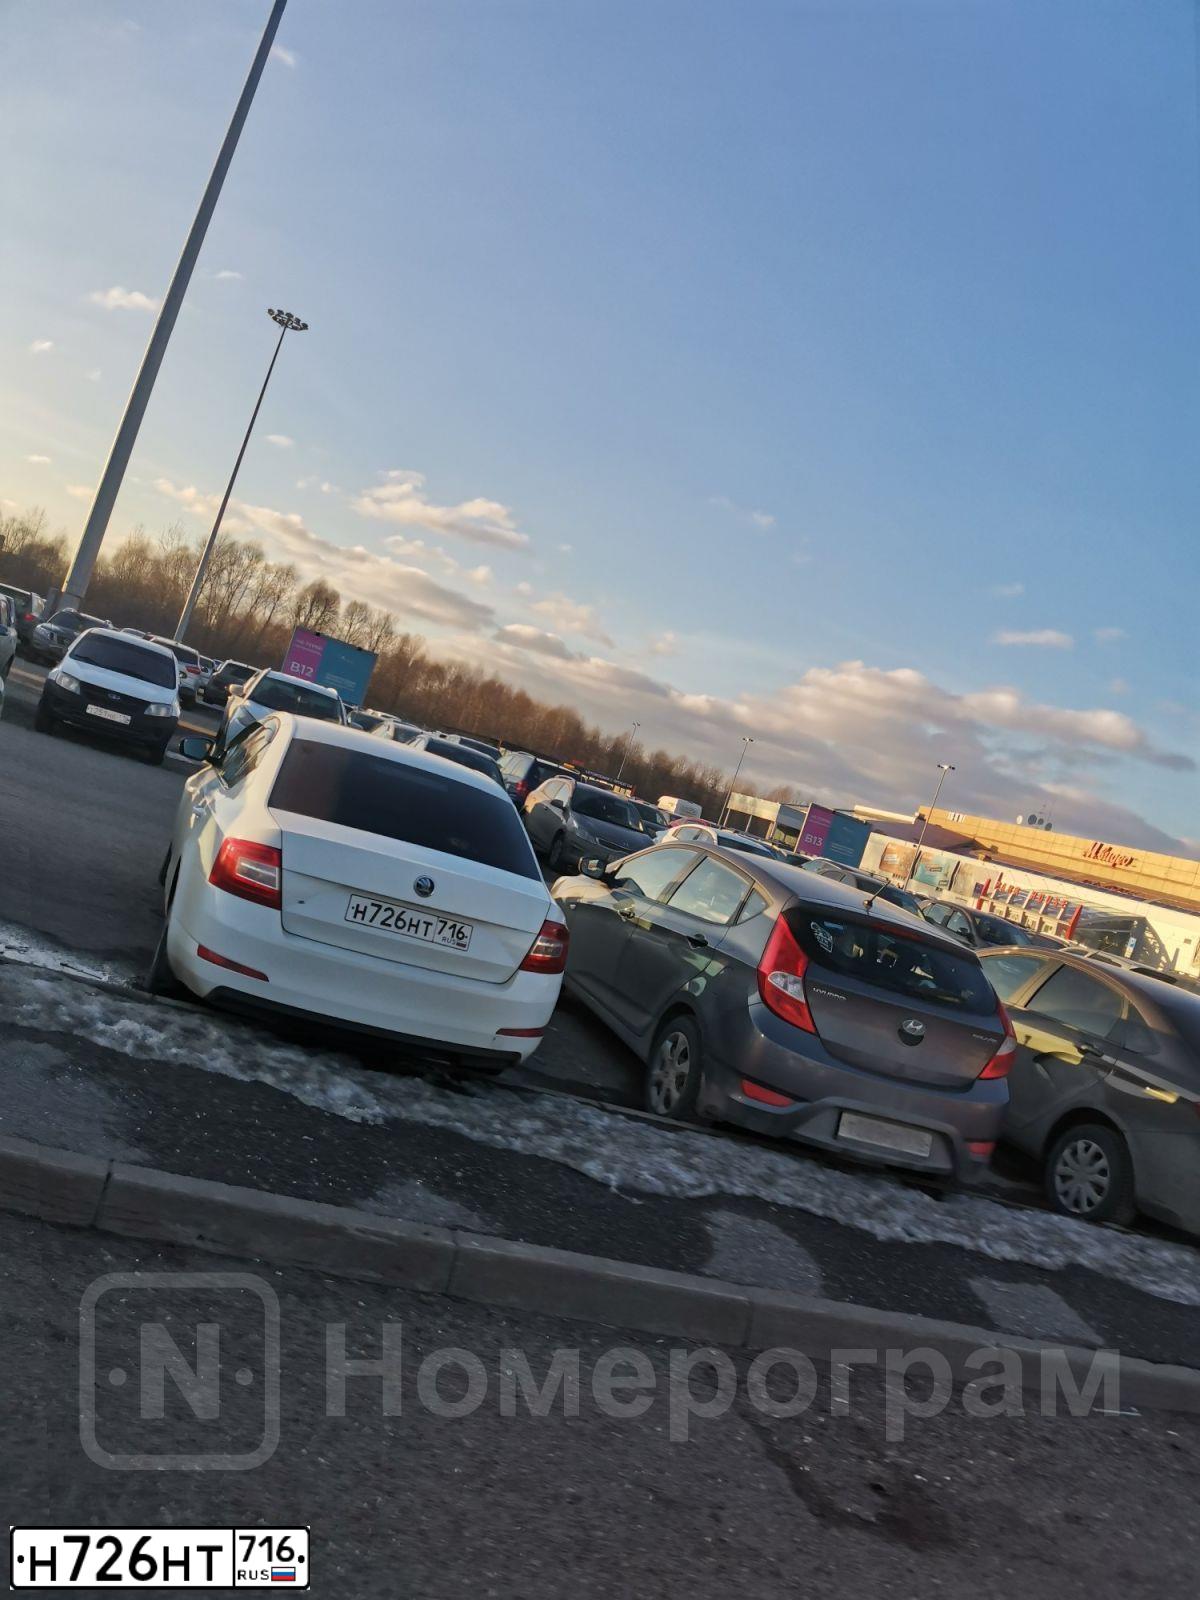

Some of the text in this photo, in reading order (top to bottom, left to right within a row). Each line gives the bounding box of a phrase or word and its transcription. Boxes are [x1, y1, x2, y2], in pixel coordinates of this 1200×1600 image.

[804, 833, 823, 847] B13
[437, 920, 466, 941] 716
[441, 936, 456, 946] RUS
